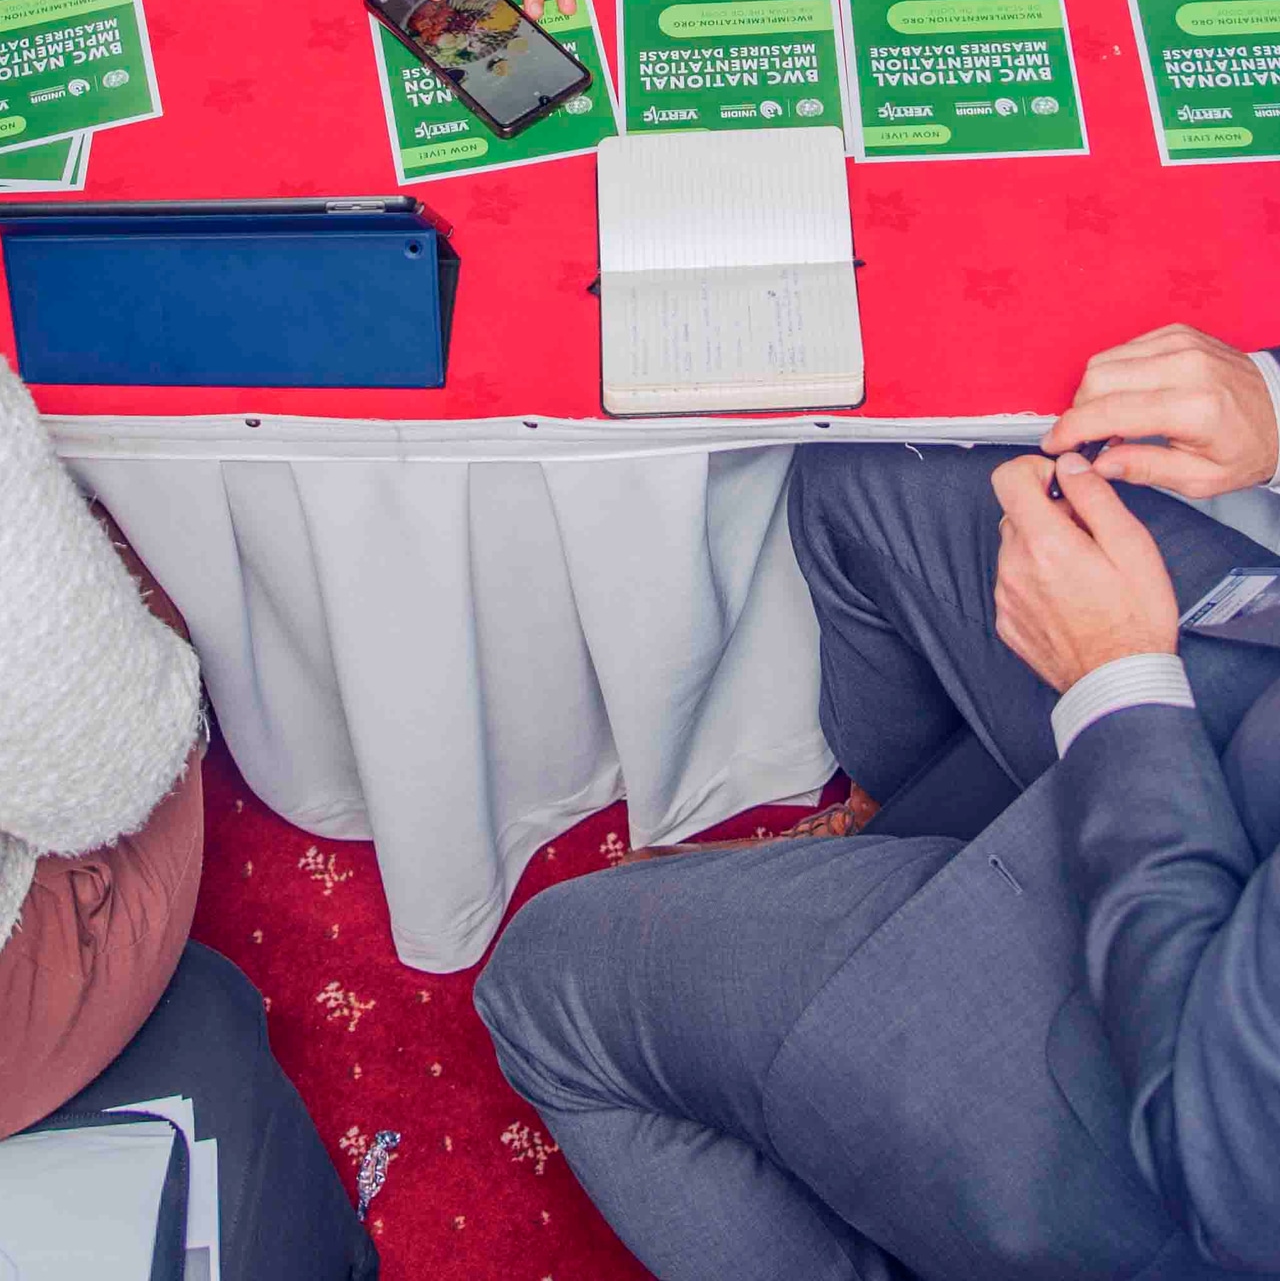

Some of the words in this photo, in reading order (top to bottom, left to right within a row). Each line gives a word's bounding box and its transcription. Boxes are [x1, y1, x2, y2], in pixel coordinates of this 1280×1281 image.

[673, 15, 813, 29] BWCIMPLEMENTATION.ORG
[902, 12, 1043, 25] BWCIMPLEMENTATION.ORG
[35, 17, 118, 44] MEASURES
[72, 41, 123, 64] BWC
[729, 43, 815, 57] MEASURES
[870, 45, 955, 57] DATABASE
[960, 40, 1047, 54] MEASURES
[1161, 45, 1247, 61] DATABASE
[639, 48, 724, 61] DATABASE
[871, 52, 1049, 71] IMPLEMENTATION
[639, 55, 818, 76] IMPLEMENTATION
[766, 69, 819, 85] BWC
[872, 69, 992, 87] NATIONAL
[1000, 66, 1052, 82] BWC
[640, 73, 757, 90] NATIONAL
[30, 88, 66, 104] UNIDIR
[720, 110, 756, 118] UNIDIR
[955, 107, 992, 116] UNIDIR
[880, 131, 908, 140] LIVE!
[912, 131, 940, 139] NOW
[1182, 133, 1211, 144] LIVE!
[1214, 132, 1242, 142] NOW
[418, 148, 446, 160] LIVE!
[450, 143, 478, 154] NOW
